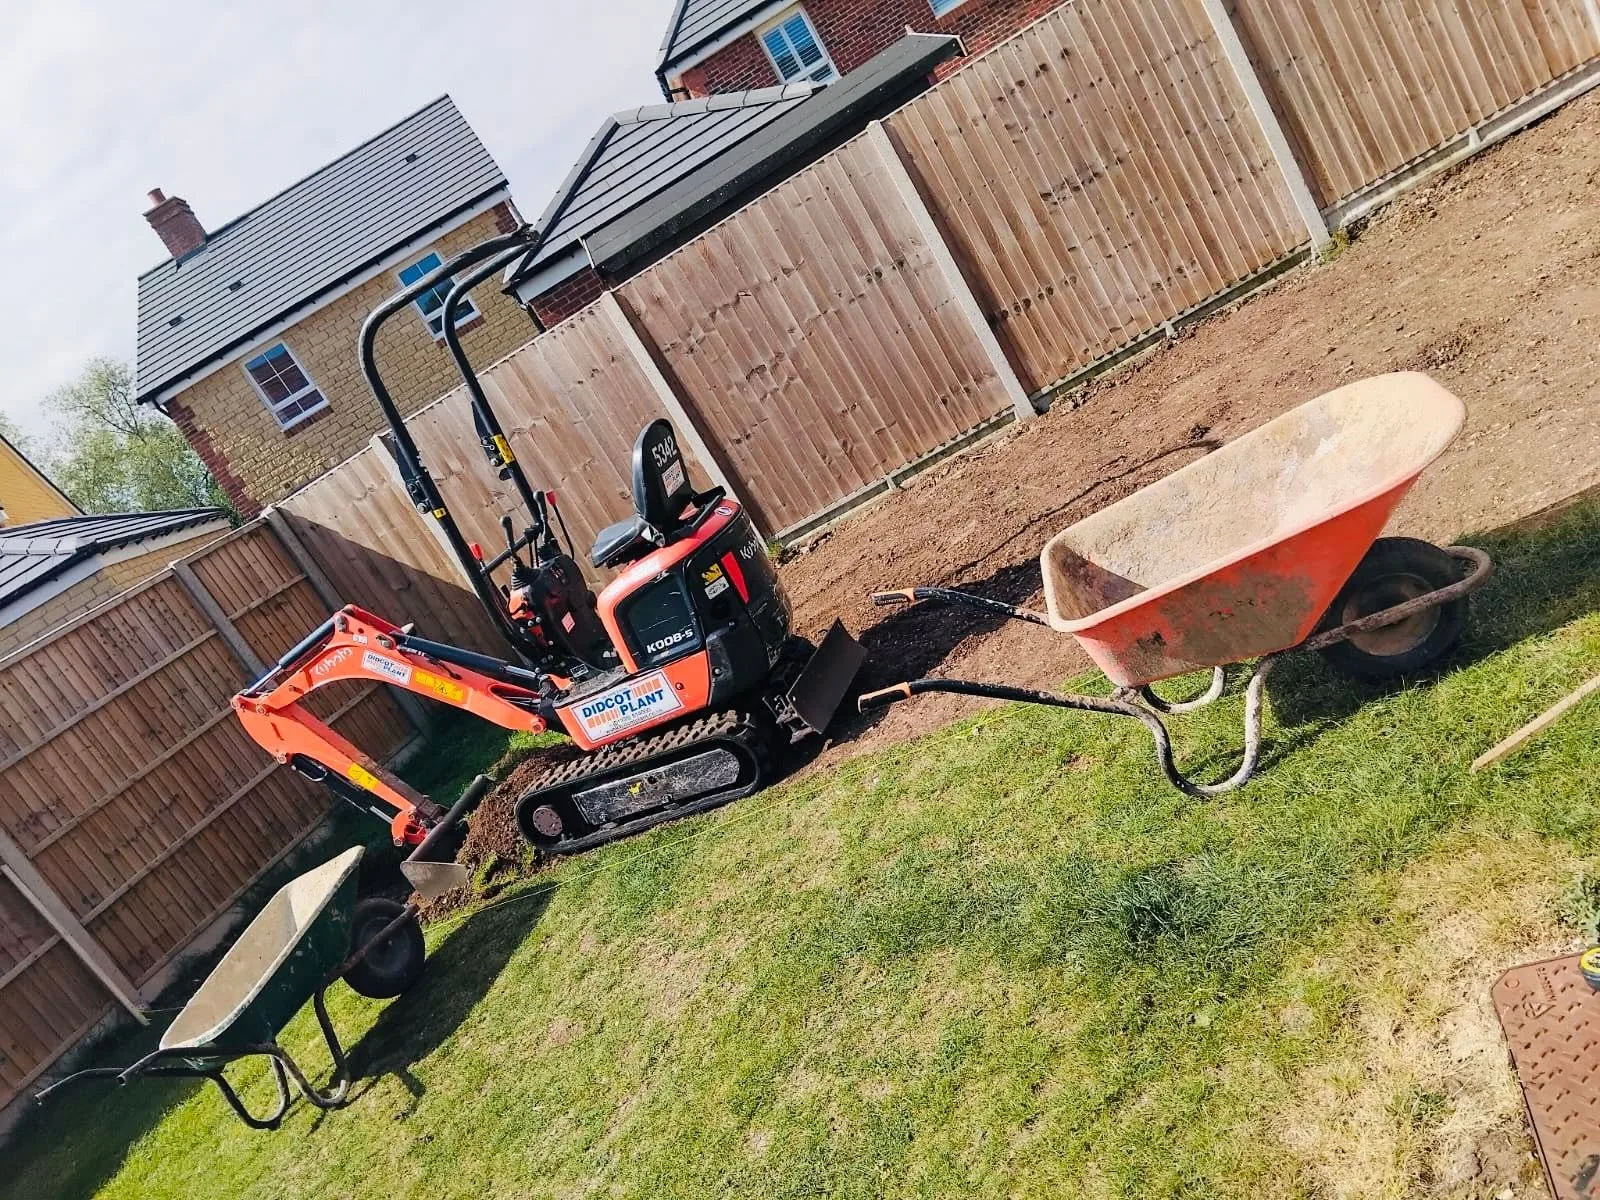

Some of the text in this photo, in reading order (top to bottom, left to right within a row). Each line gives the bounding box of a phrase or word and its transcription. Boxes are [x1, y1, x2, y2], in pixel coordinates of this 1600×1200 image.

[652, 436, 677, 467] 5342
[646, 628, 694, 653] K008-5
[367, 653, 394, 668] DIDCOT
[383, 664, 405, 678] PLANT
[582, 689, 632, 718] DIDCOT
[620, 689, 664, 716] PLANT
